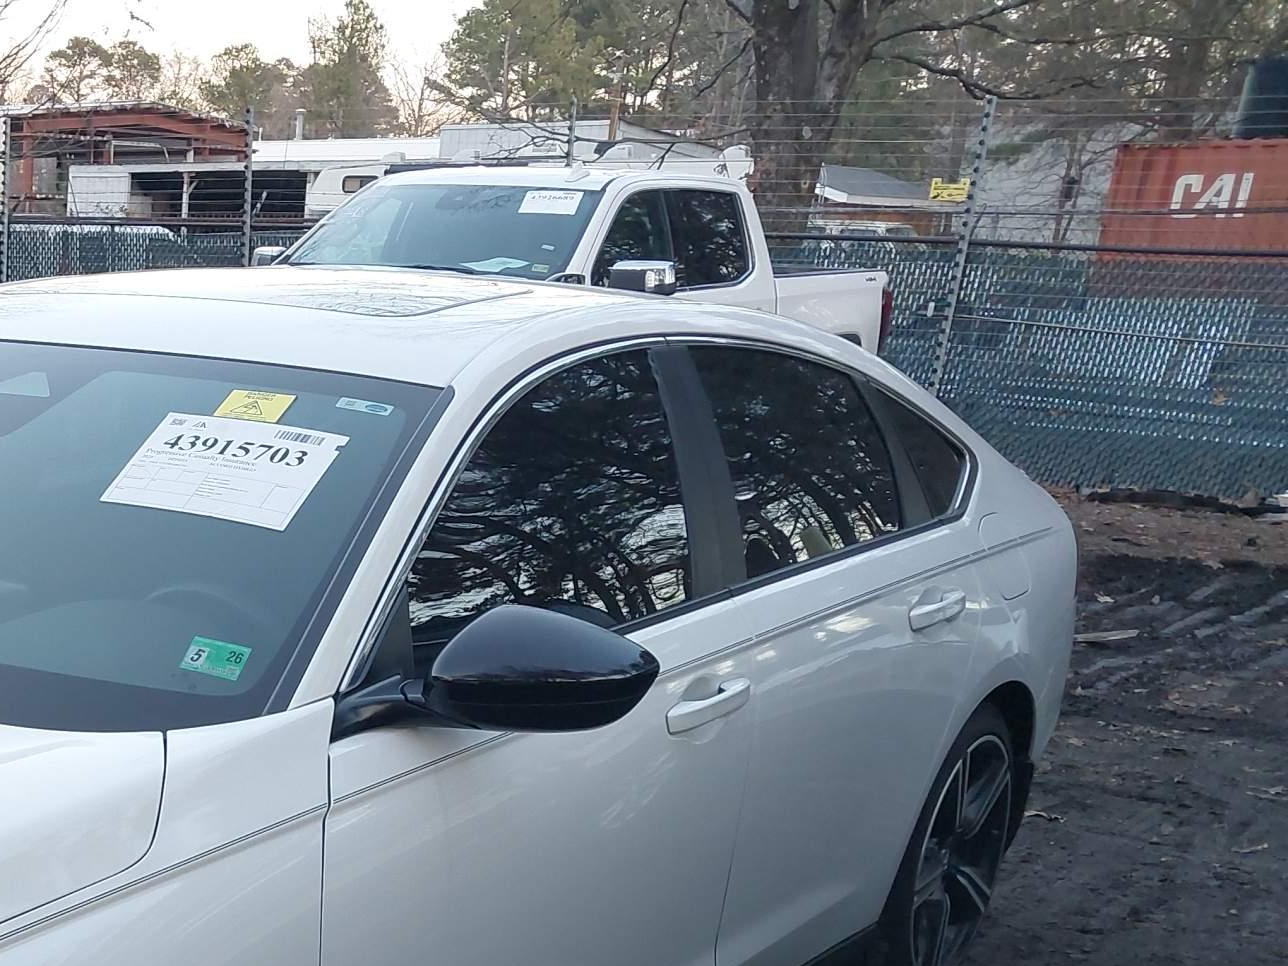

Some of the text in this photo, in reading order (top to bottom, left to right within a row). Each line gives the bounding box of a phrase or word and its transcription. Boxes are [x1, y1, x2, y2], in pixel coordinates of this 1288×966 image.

[1170, 172, 1254, 218] CAI
[163, 433, 308, 467] 43915703
[190, 648, 205, 662] 5
[225, 650, 244, 664] 26
